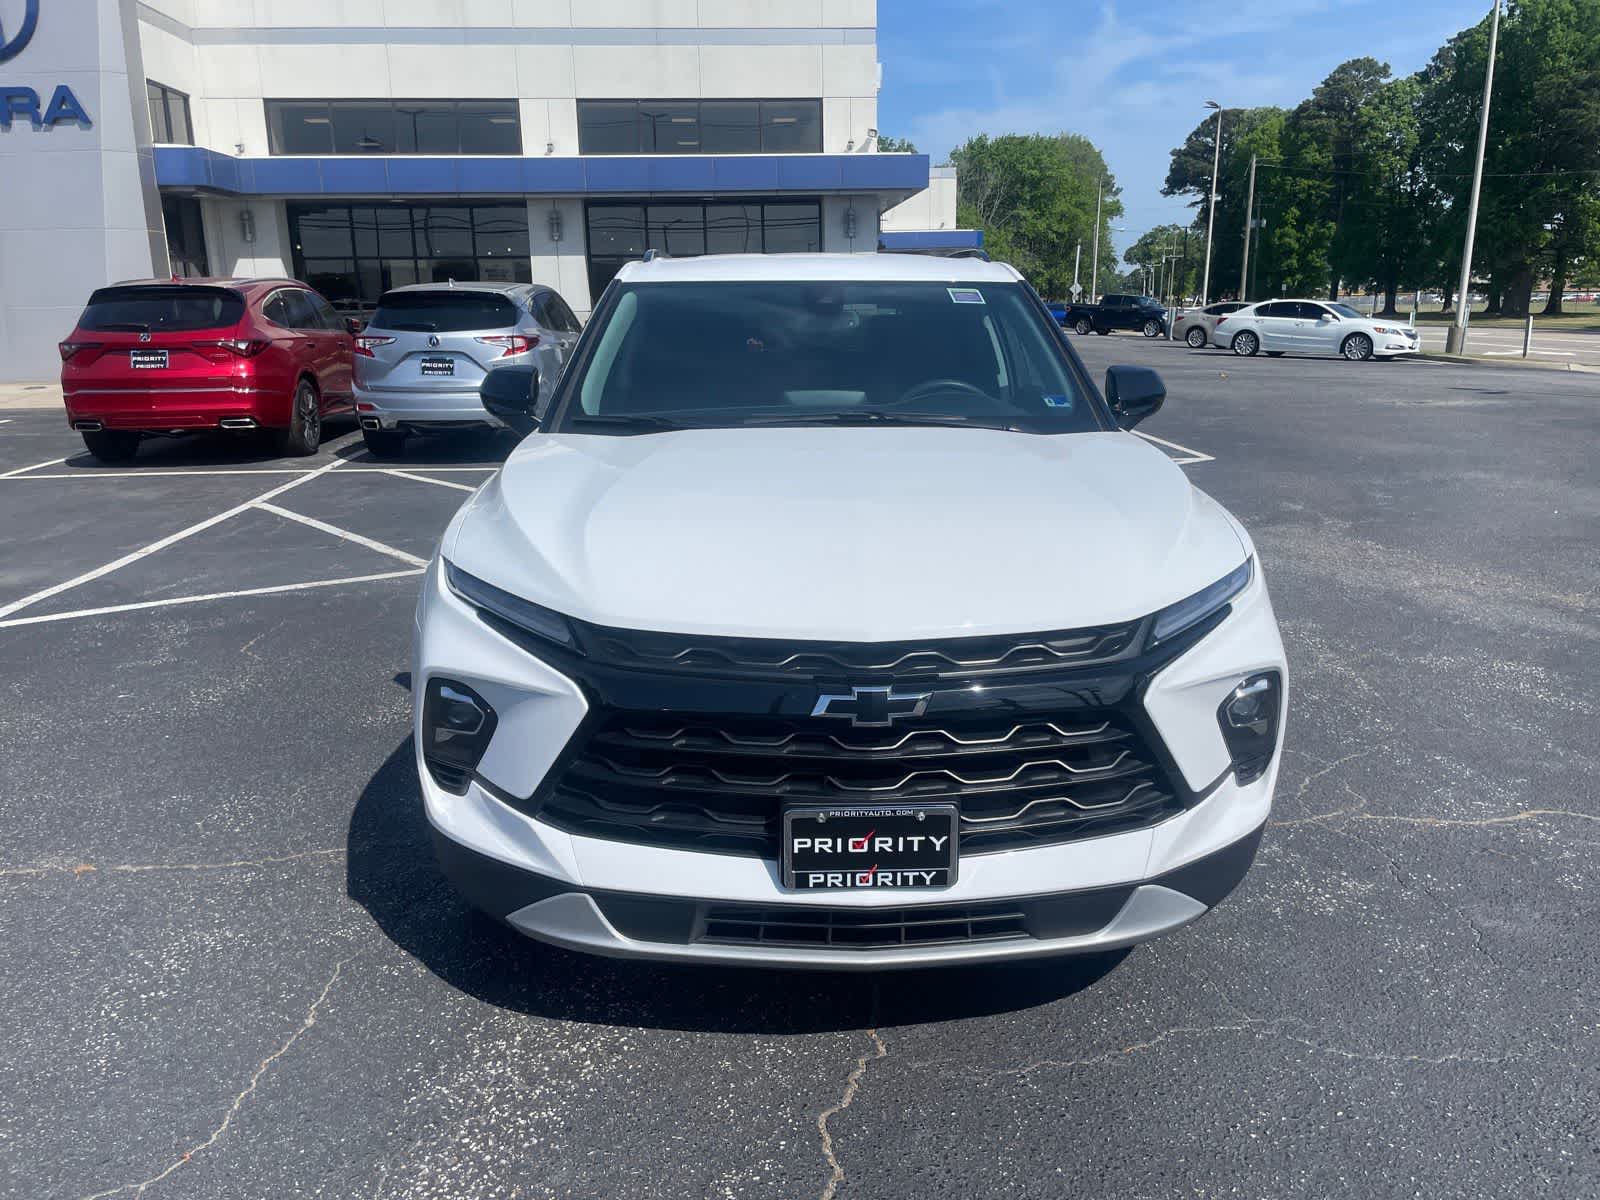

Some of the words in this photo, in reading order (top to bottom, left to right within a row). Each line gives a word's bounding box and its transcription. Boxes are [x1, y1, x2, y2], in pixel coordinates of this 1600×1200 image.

[829, 809, 914, 817] PRIORITYAUTO.COM
[793, 835, 948, 853] PRIORITY
[808, 871, 936, 888] PRIORITY
